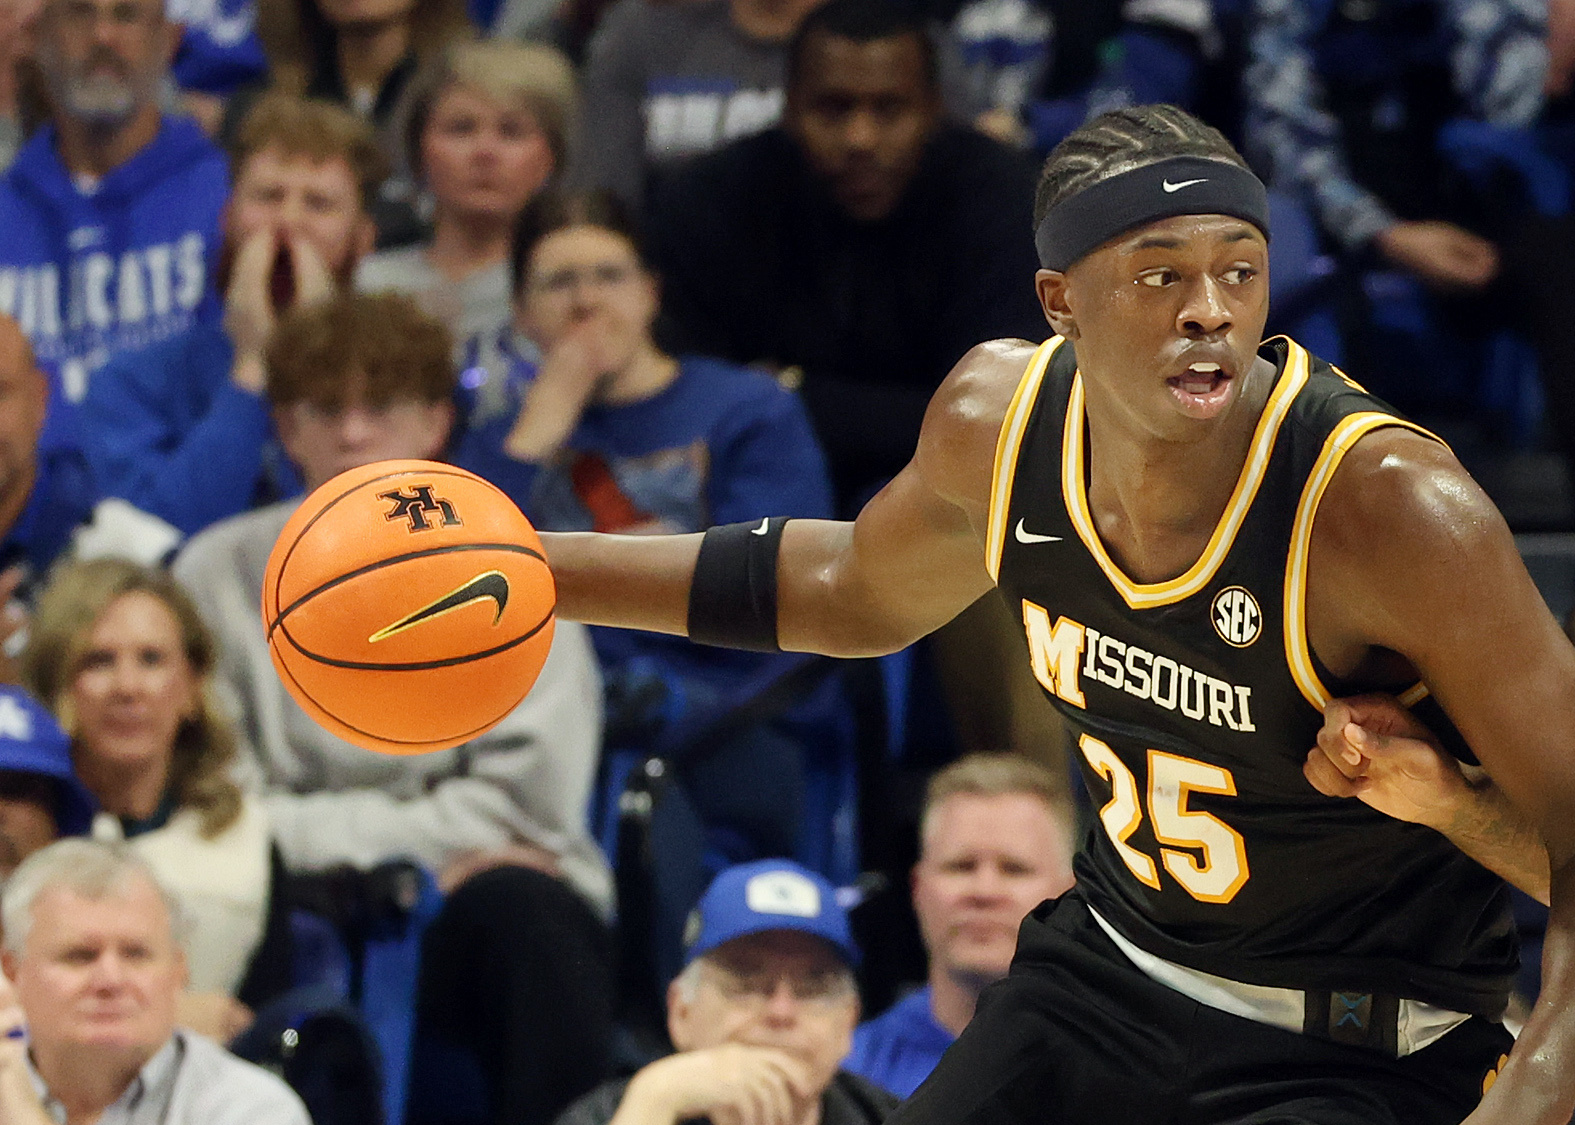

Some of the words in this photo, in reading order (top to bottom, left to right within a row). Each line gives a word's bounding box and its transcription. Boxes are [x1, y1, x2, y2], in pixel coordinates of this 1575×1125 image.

[1022, 598, 1256, 732] MISSOURI
[1215, 590, 1258, 643] SEC
[1079, 732, 1250, 904] 25
